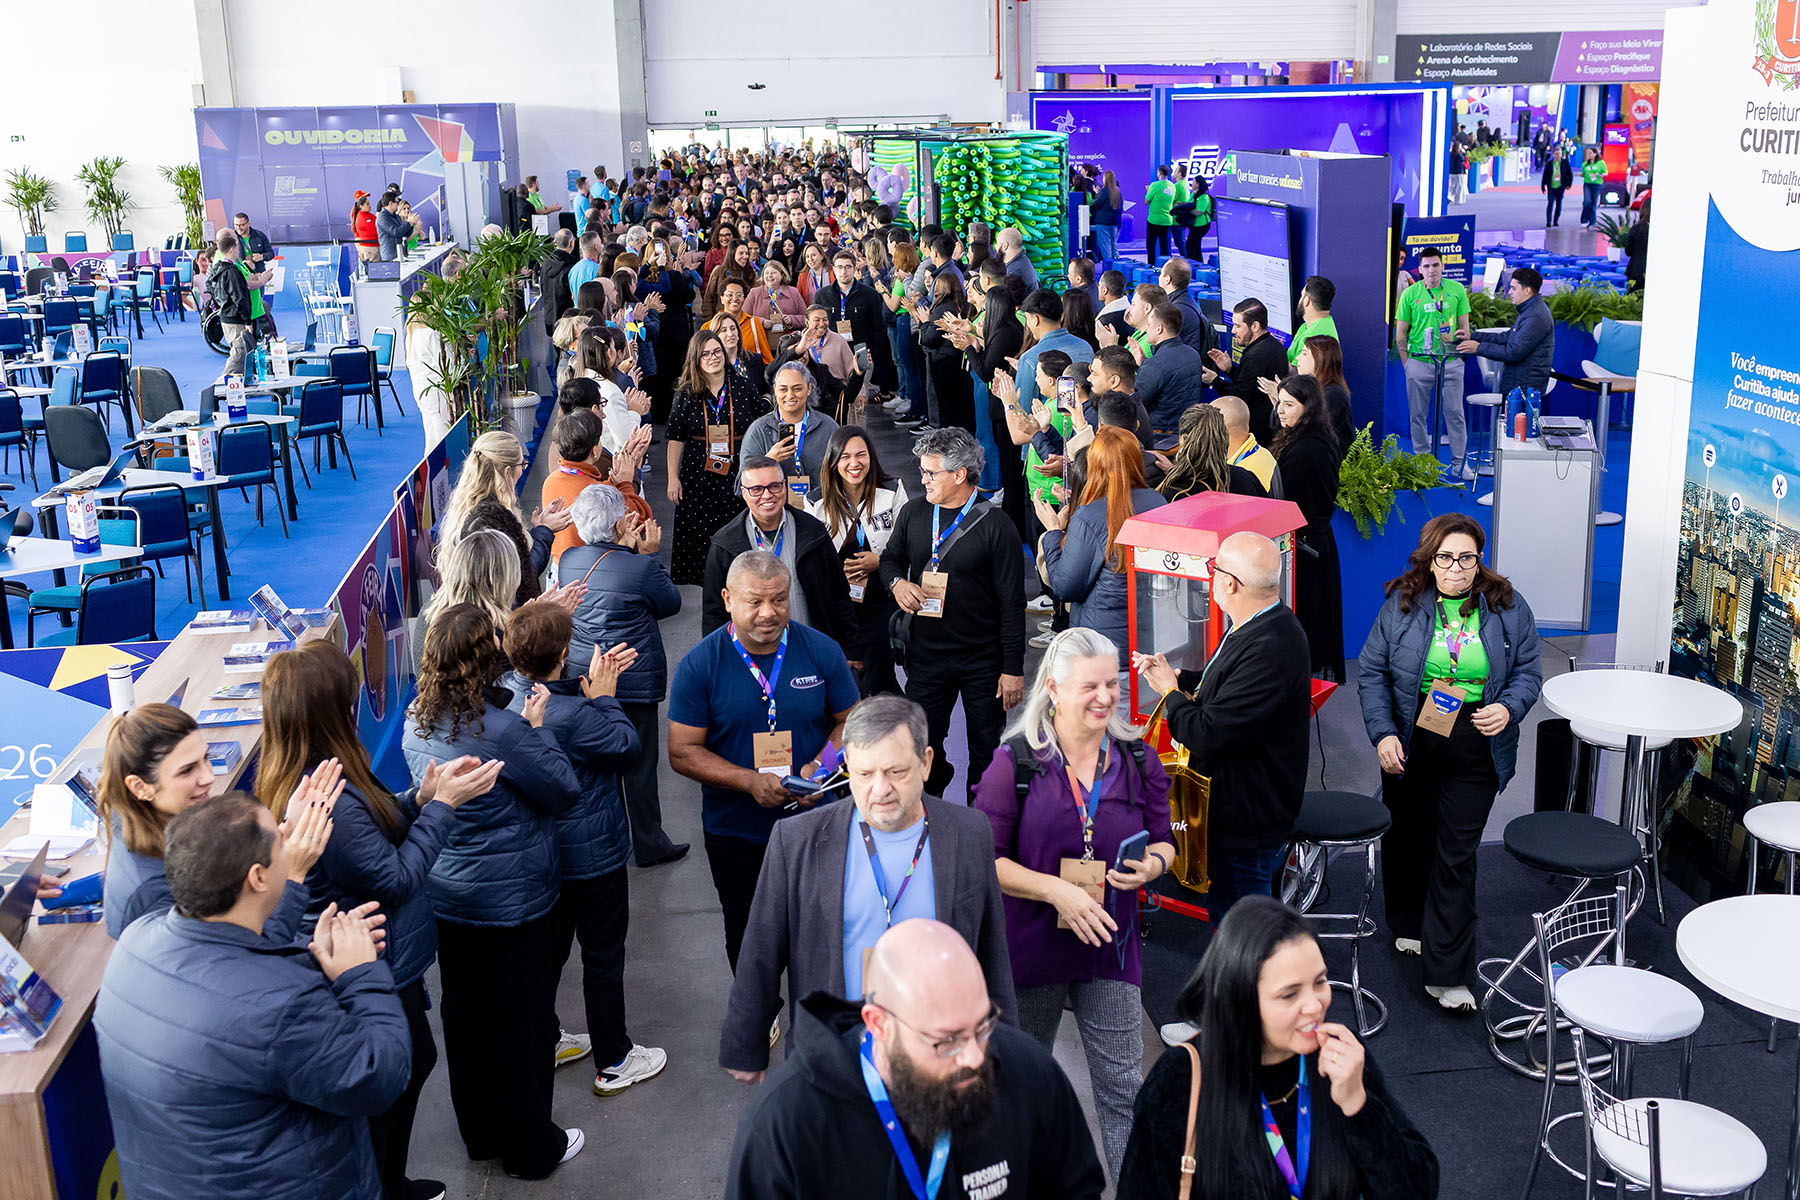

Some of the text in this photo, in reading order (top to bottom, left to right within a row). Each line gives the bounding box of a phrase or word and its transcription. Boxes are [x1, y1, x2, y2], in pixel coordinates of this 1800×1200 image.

[1430, 40, 1533, 52] Laboratório de Redes Sociais
[1590, 40, 1608, 49] Faça
[1623, 39, 1641, 48] Ideia
[1642, 38, 1662, 47] Virar
[1426, 54, 1519, 64] Arena do Conhecimento
[1587, 51, 1651, 62] Espaço Precifique
[1423, 67, 1498, 79] Espaço Atualidades
[1583, 63, 1655, 75] Espaço Diagnóstico
[1745, 101, 1800, 122] Prefeitur
[265, 128, 408, 145] OUVIDORIA
[1740, 127, 1800, 155] CURITI
[1412, 244, 1462, 257] peunta
[1731, 351, 1800, 385] Você empreen
[229, 382, 240, 390] 03
[1733, 374, 1800, 405] Curitiba ajuda
[1724, 388, 1800, 427] fazer acontece
[202, 437, 210, 446] 04
[68, 504, 78, 514] 05
[85, 503, 94, 513] 05
[0, 744, 57, 780] 26
[1171, 819, 1188, 832] nk
[962, 1160, 1011, 1192] PERSONAL
